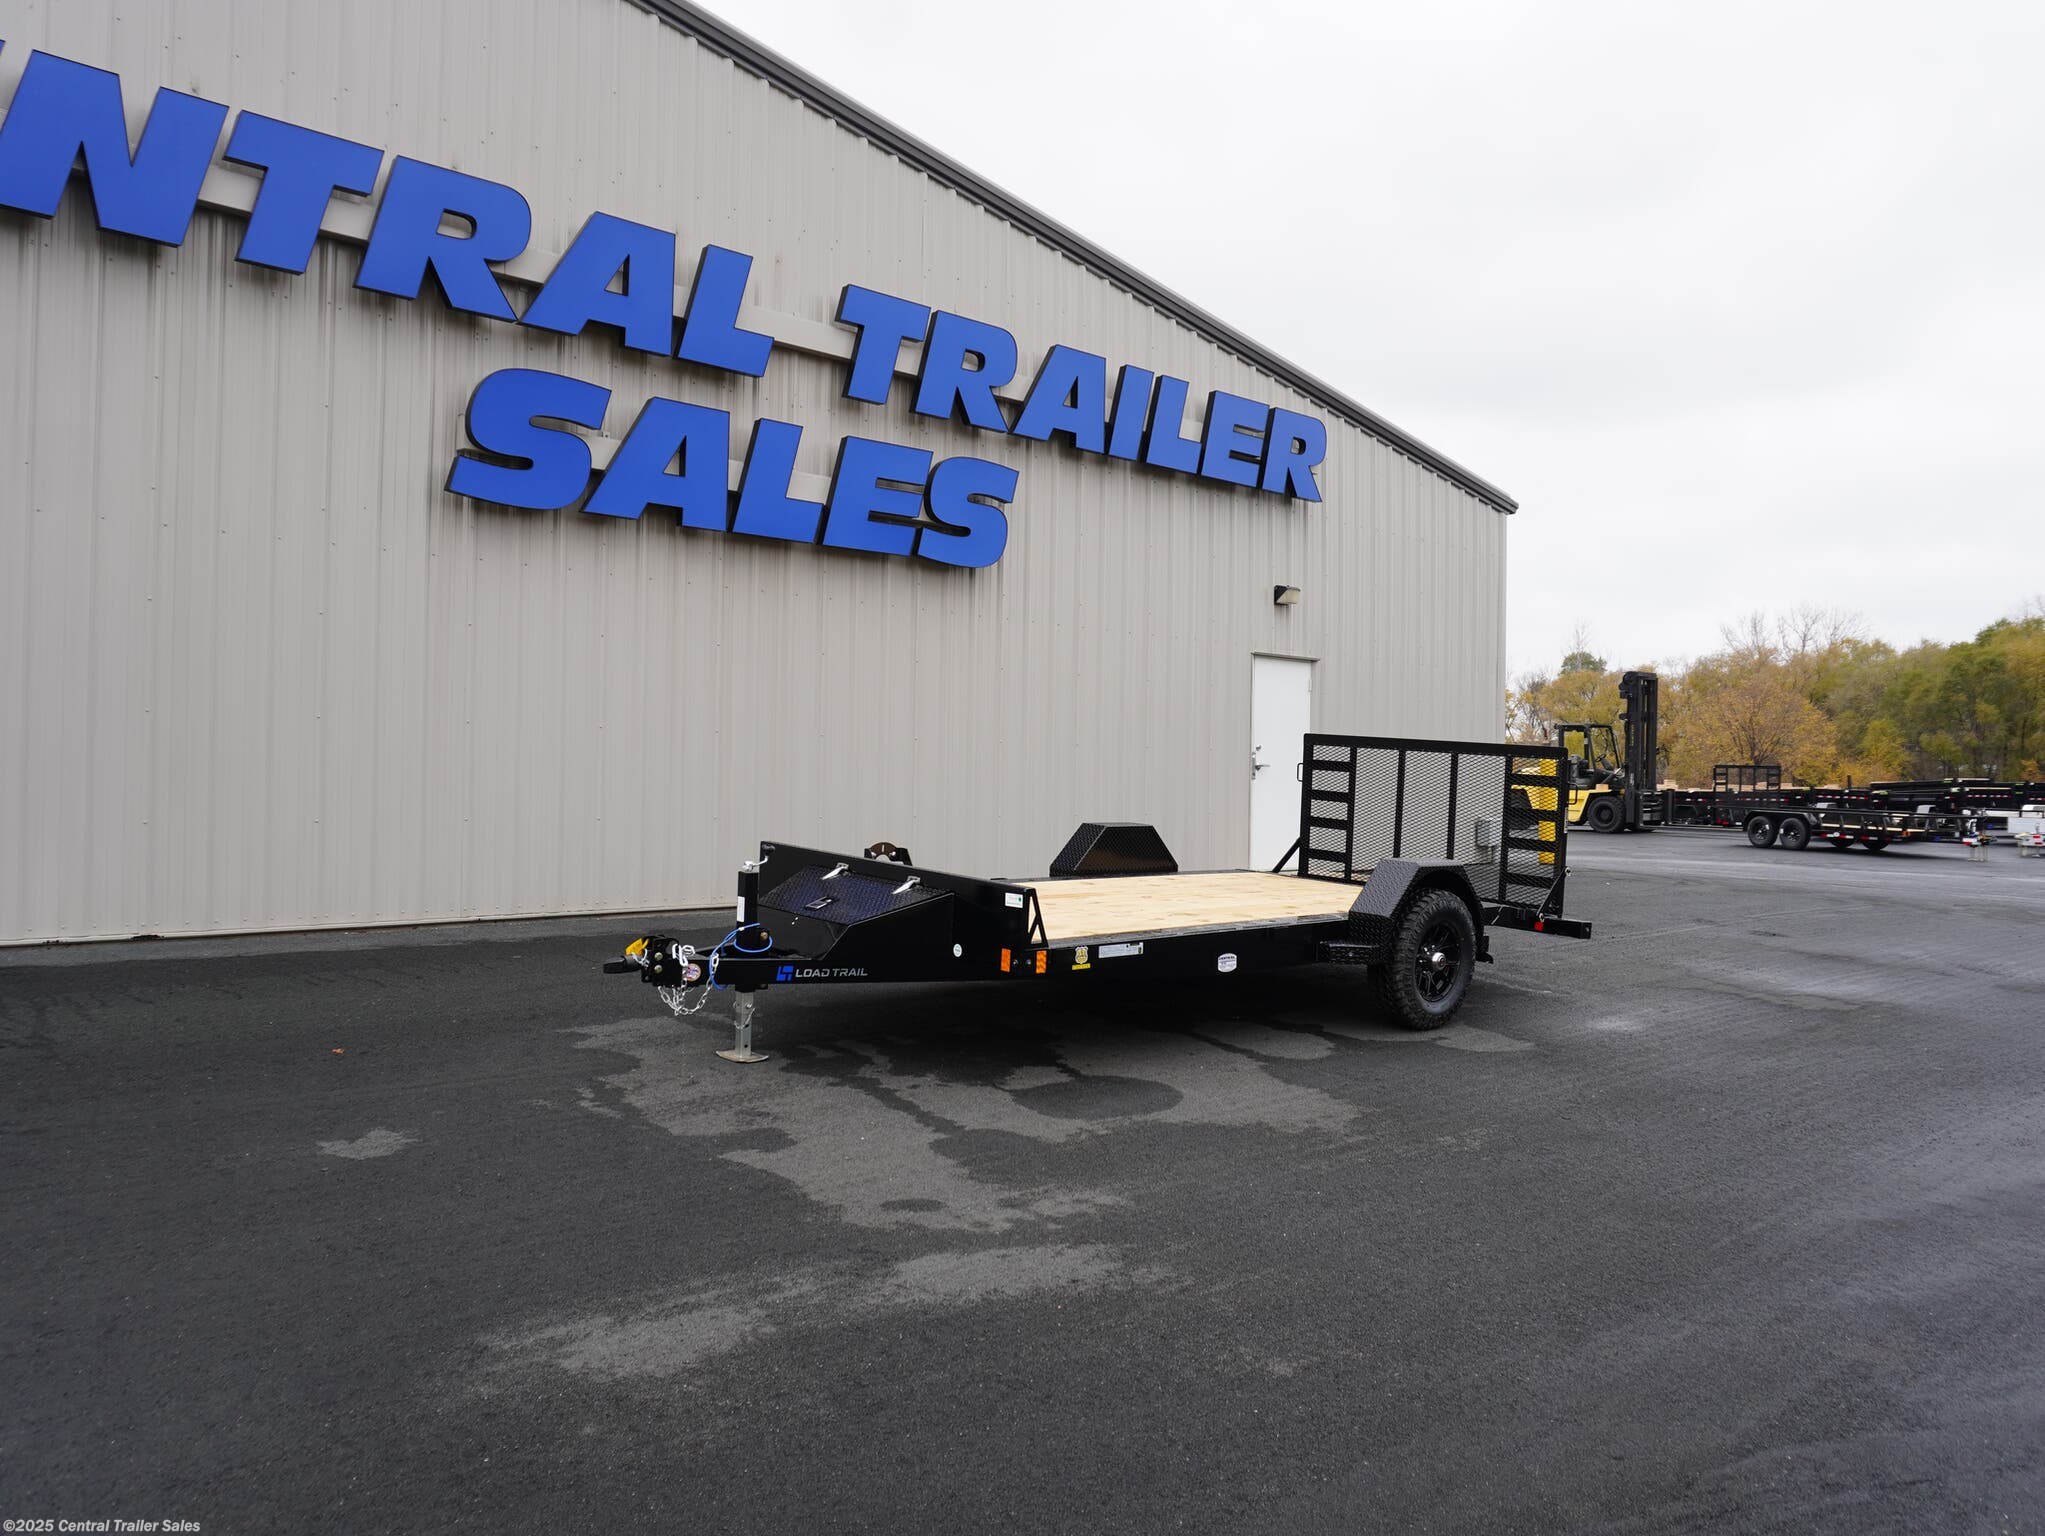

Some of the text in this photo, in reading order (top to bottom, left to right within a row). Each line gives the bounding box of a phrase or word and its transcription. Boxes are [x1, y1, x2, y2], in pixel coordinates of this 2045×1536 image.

[0, 39, 1327, 503] NTRAL TRAILER
[445, 368, 1019, 569] SALES
[795, 967, 830, 978] LOAD
[832, 967, 869, 977] TRAIL
